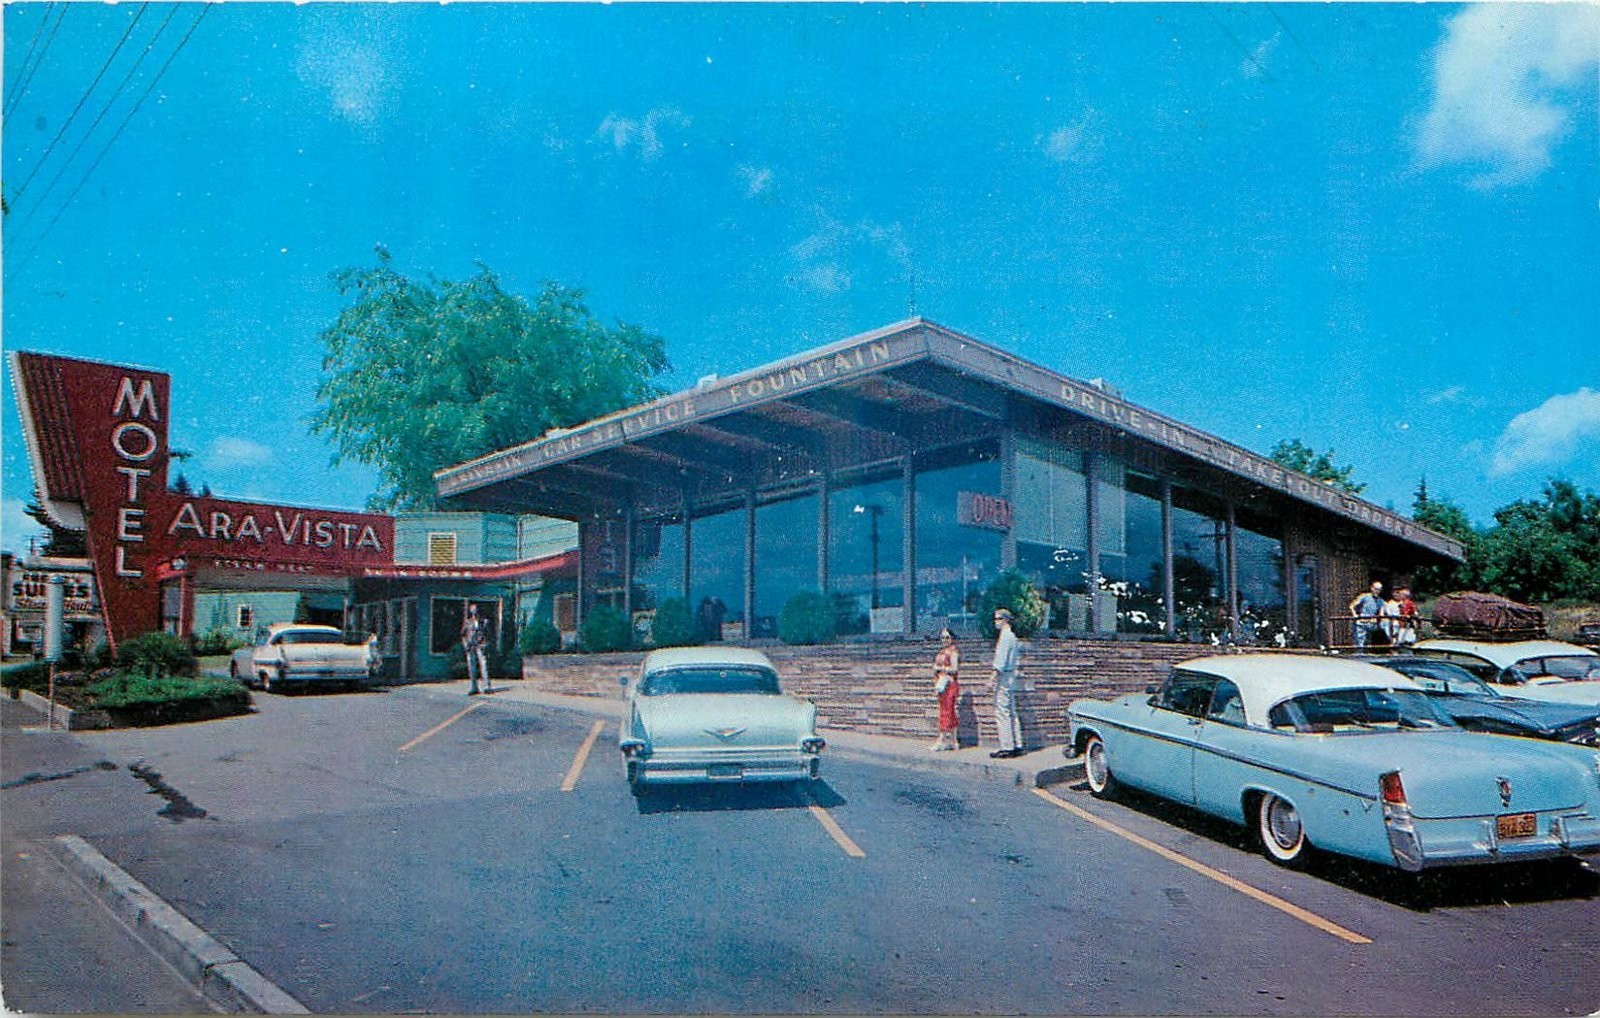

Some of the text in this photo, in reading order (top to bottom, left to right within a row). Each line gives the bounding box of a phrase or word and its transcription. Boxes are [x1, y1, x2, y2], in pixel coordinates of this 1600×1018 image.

[543, 436, 582, 459] CAR
[592, 400, 696, 443] SERVICE
[730, 343, 891, 405] FOUNTAIN
[1060, 385, 1186, 446] DRIVE-IN
[111, 375, 160, 579] MOTEL
[167, 501, 385, 553] ARA-VISTA
